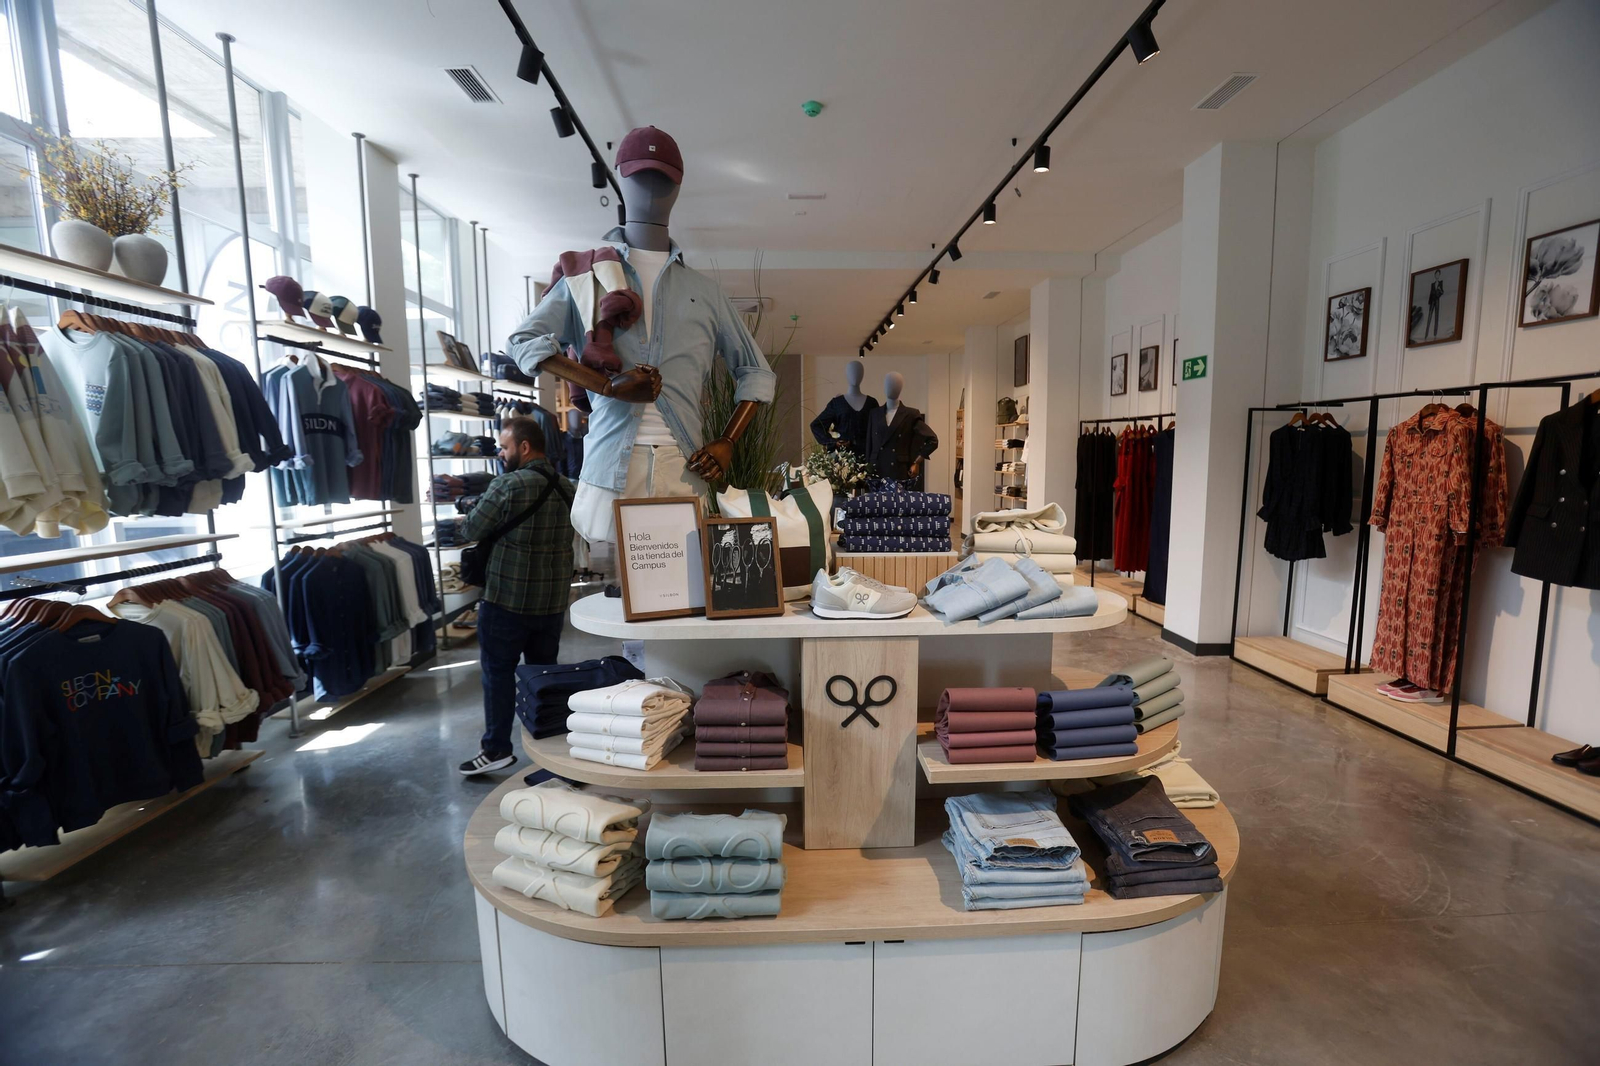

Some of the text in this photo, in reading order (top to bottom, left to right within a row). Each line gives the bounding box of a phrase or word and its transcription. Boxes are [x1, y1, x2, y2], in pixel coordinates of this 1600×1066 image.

[629, 532, 651, 541] Hola
[630, 542, 679, 551] Bienvenidos
[671, 550, 684, 558] del
[631, 562, 666, 570] Campus
[66, 679, 141, 712] COMPANY
